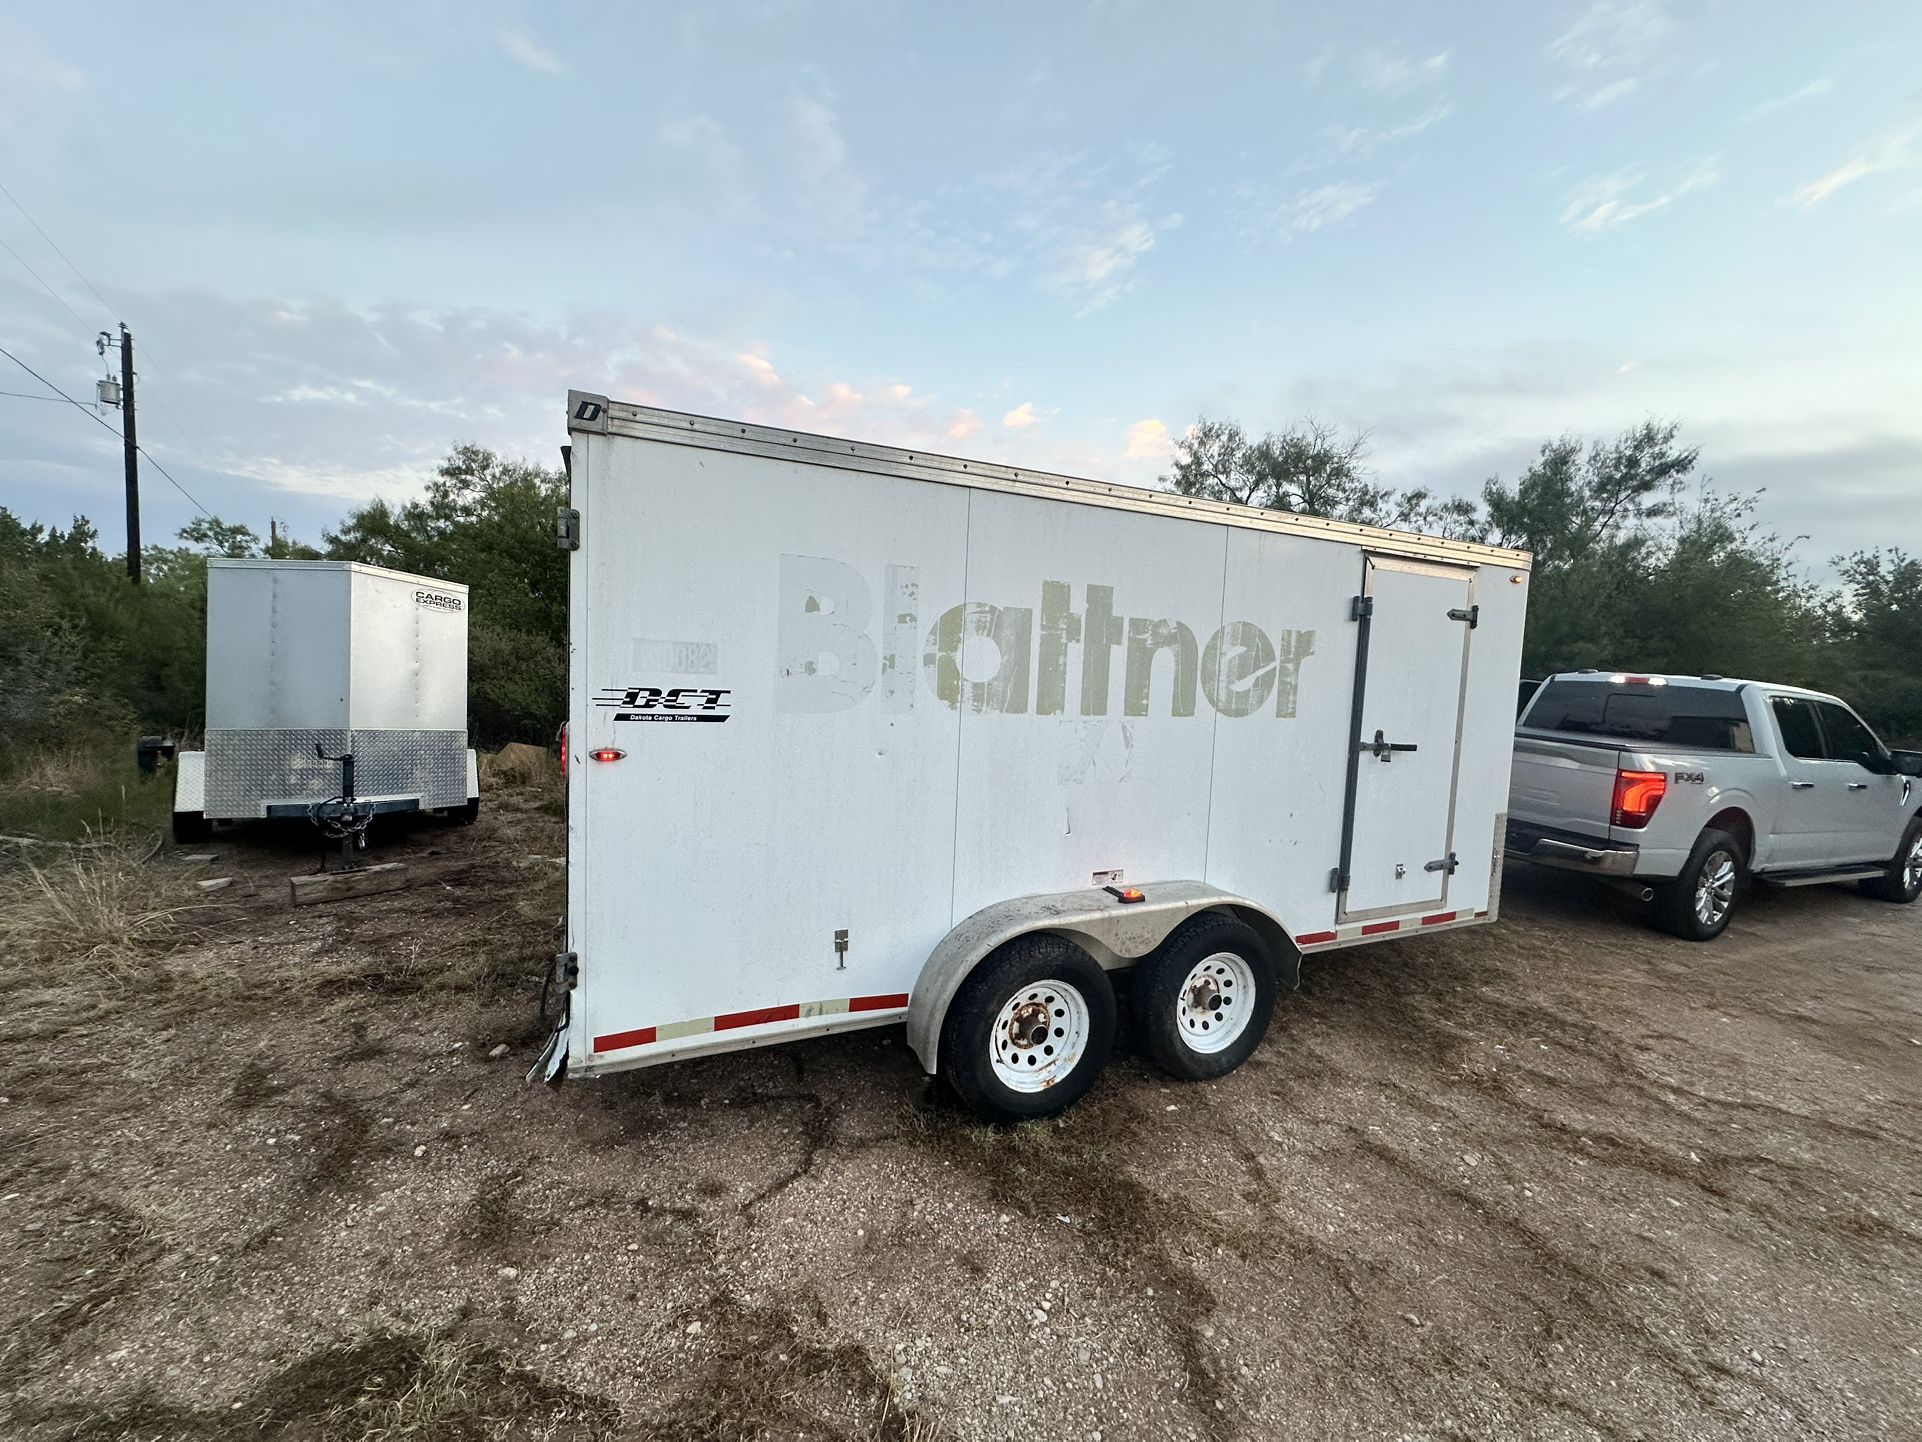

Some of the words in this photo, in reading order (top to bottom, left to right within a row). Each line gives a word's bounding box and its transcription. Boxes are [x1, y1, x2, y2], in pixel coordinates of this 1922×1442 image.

[416, 591, 461, 606] CARGO
[416, 597, 461, 610] EXPRESS
[775, 553, 1316, 719] Blattner
[619, 687, 731, 710] DCT
[1674, 772, 1704, 784] FX4
